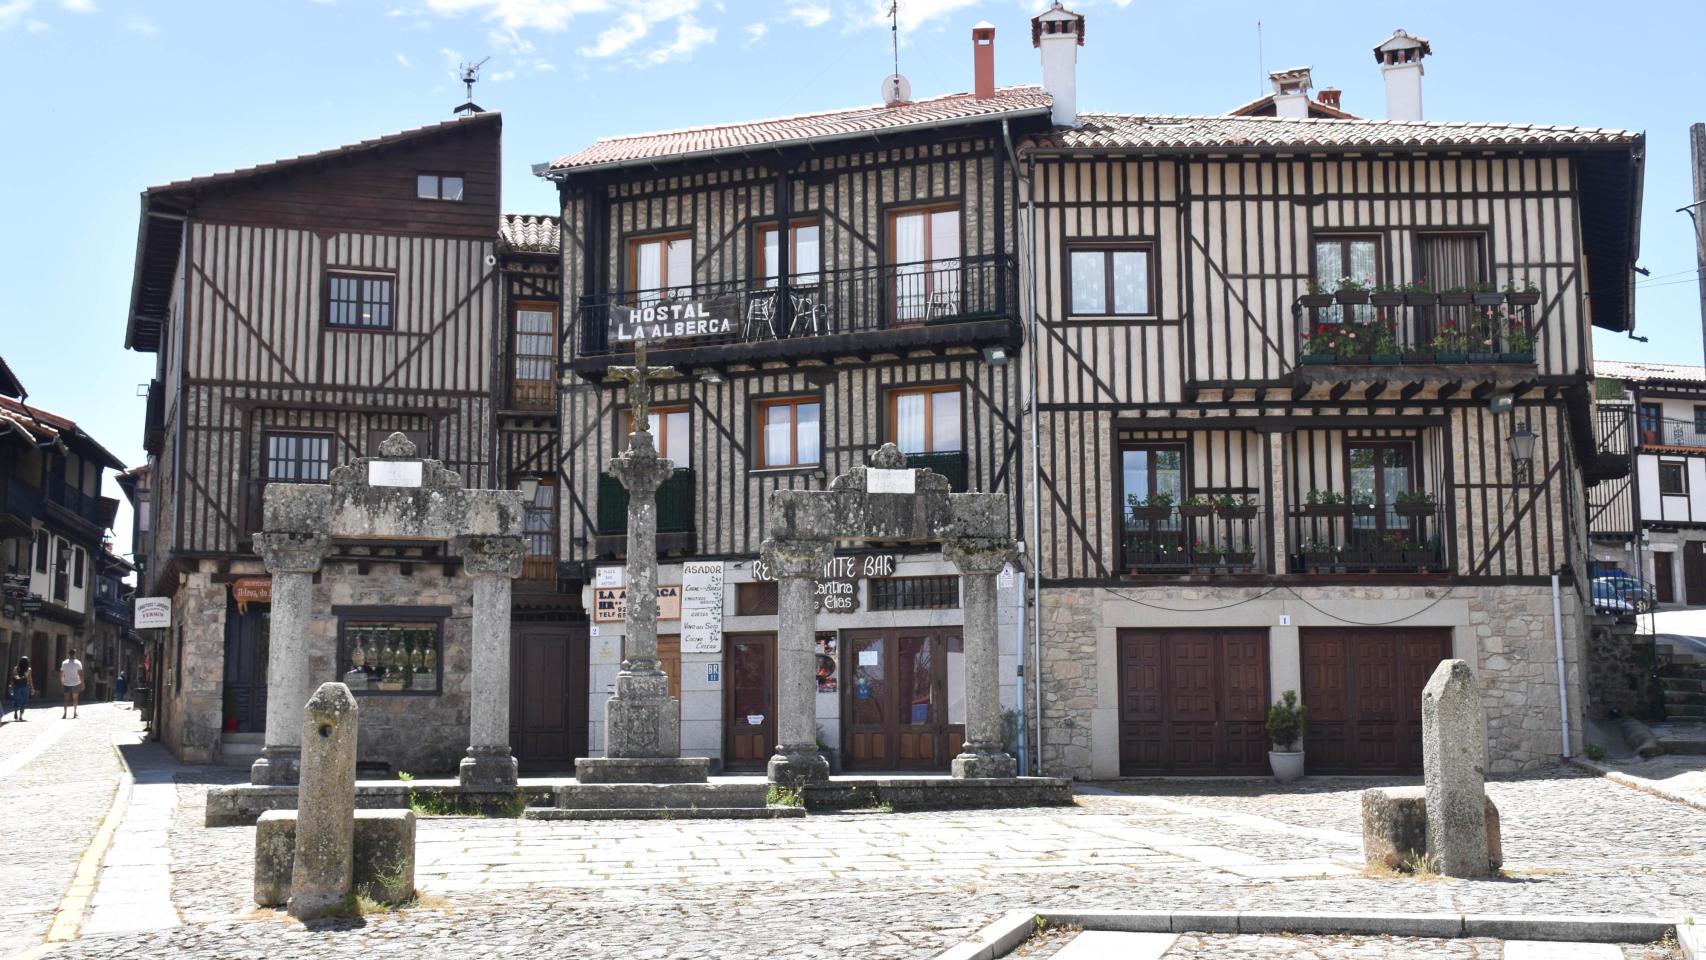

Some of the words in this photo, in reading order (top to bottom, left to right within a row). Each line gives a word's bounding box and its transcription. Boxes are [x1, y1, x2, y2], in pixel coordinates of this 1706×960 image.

[629, 302, 710, 324] HOSTAL
[617, 323, 645, 340] LA
[651, 318, 731, 338] ALBERCA
[684, 565, 722, 574] ASADOR
[863, 555, 893, 576] BAR
[598, 590, 615, 599] LA
[708, 664, 718, 674] BR
